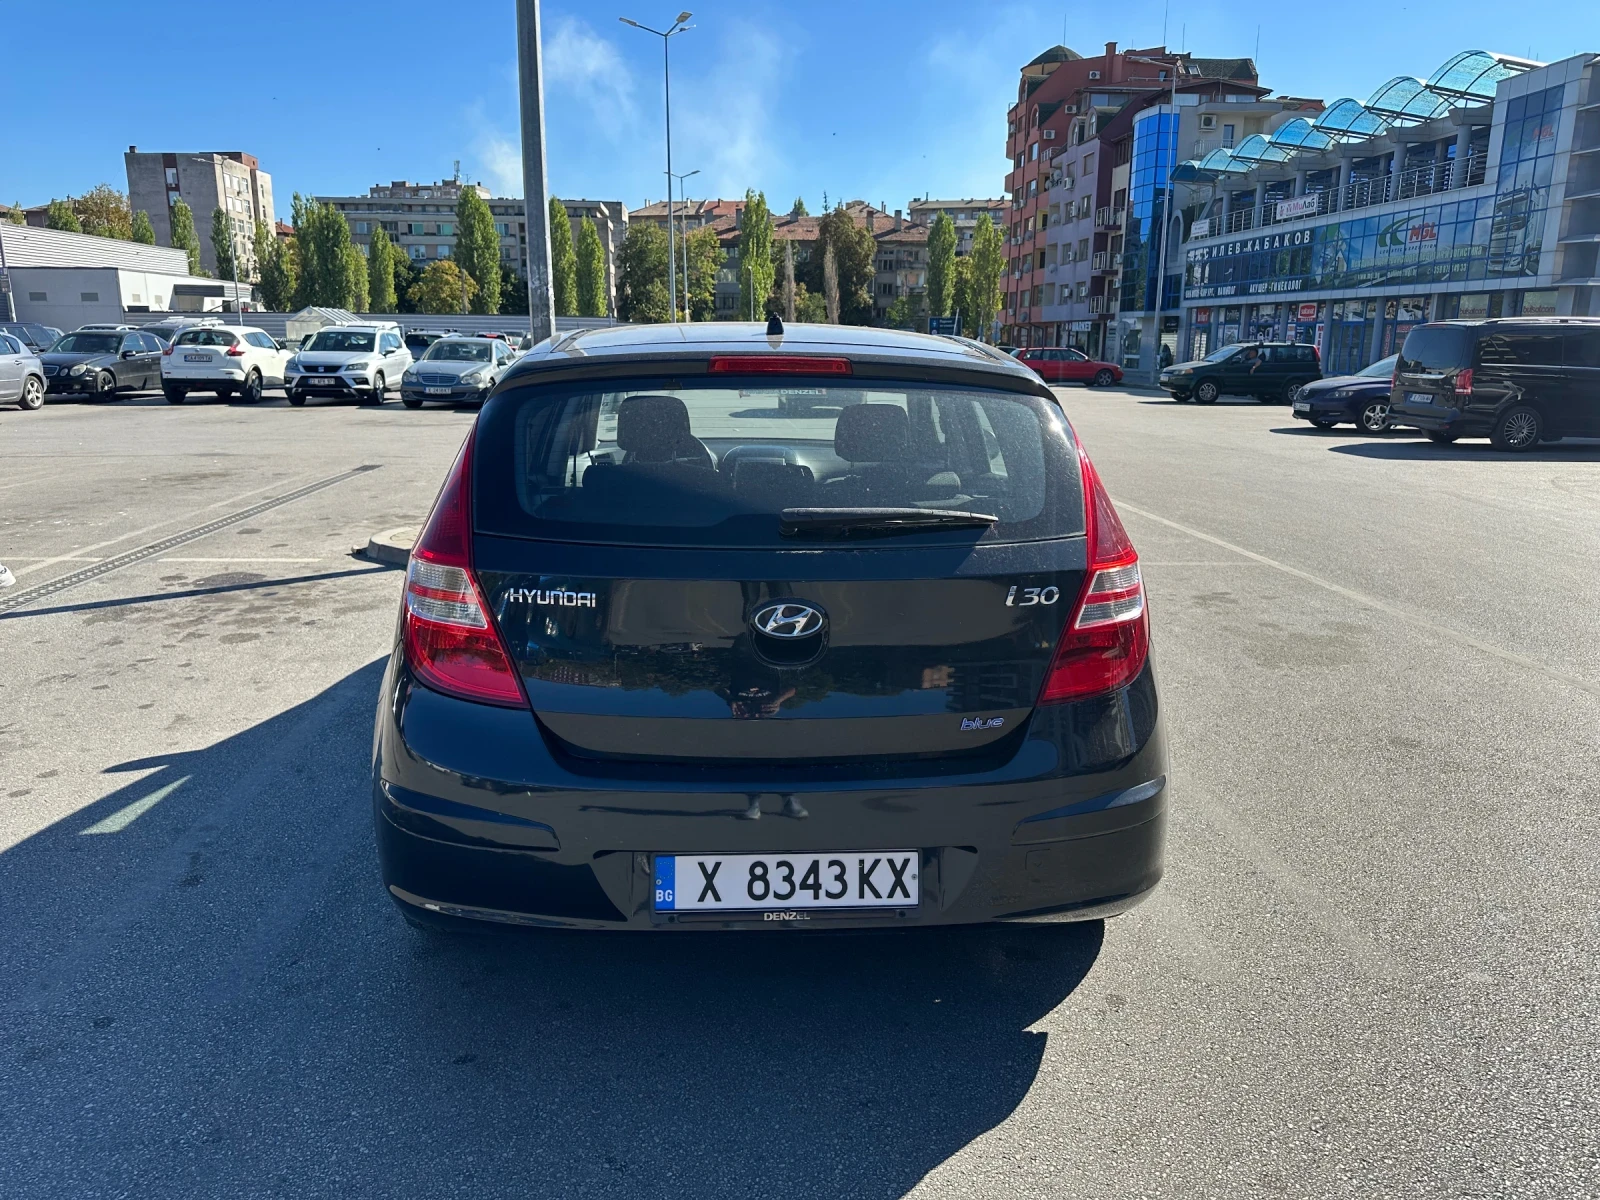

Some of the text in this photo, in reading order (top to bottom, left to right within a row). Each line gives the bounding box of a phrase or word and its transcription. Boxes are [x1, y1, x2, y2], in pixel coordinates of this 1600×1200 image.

[1409, 221, 1437, 240] MGL
[1188, 230, 1311, 262] СИЛЕВ КАБАКОВ
[1379, 247, 1403, 255] LOGSTIC
[509, 587, 597, 608] HYUNDAI
[960, 717, 1005, 731] blue
[655, 889, 673, 902] BG
[763, 911, 811, 922] DENZEL
